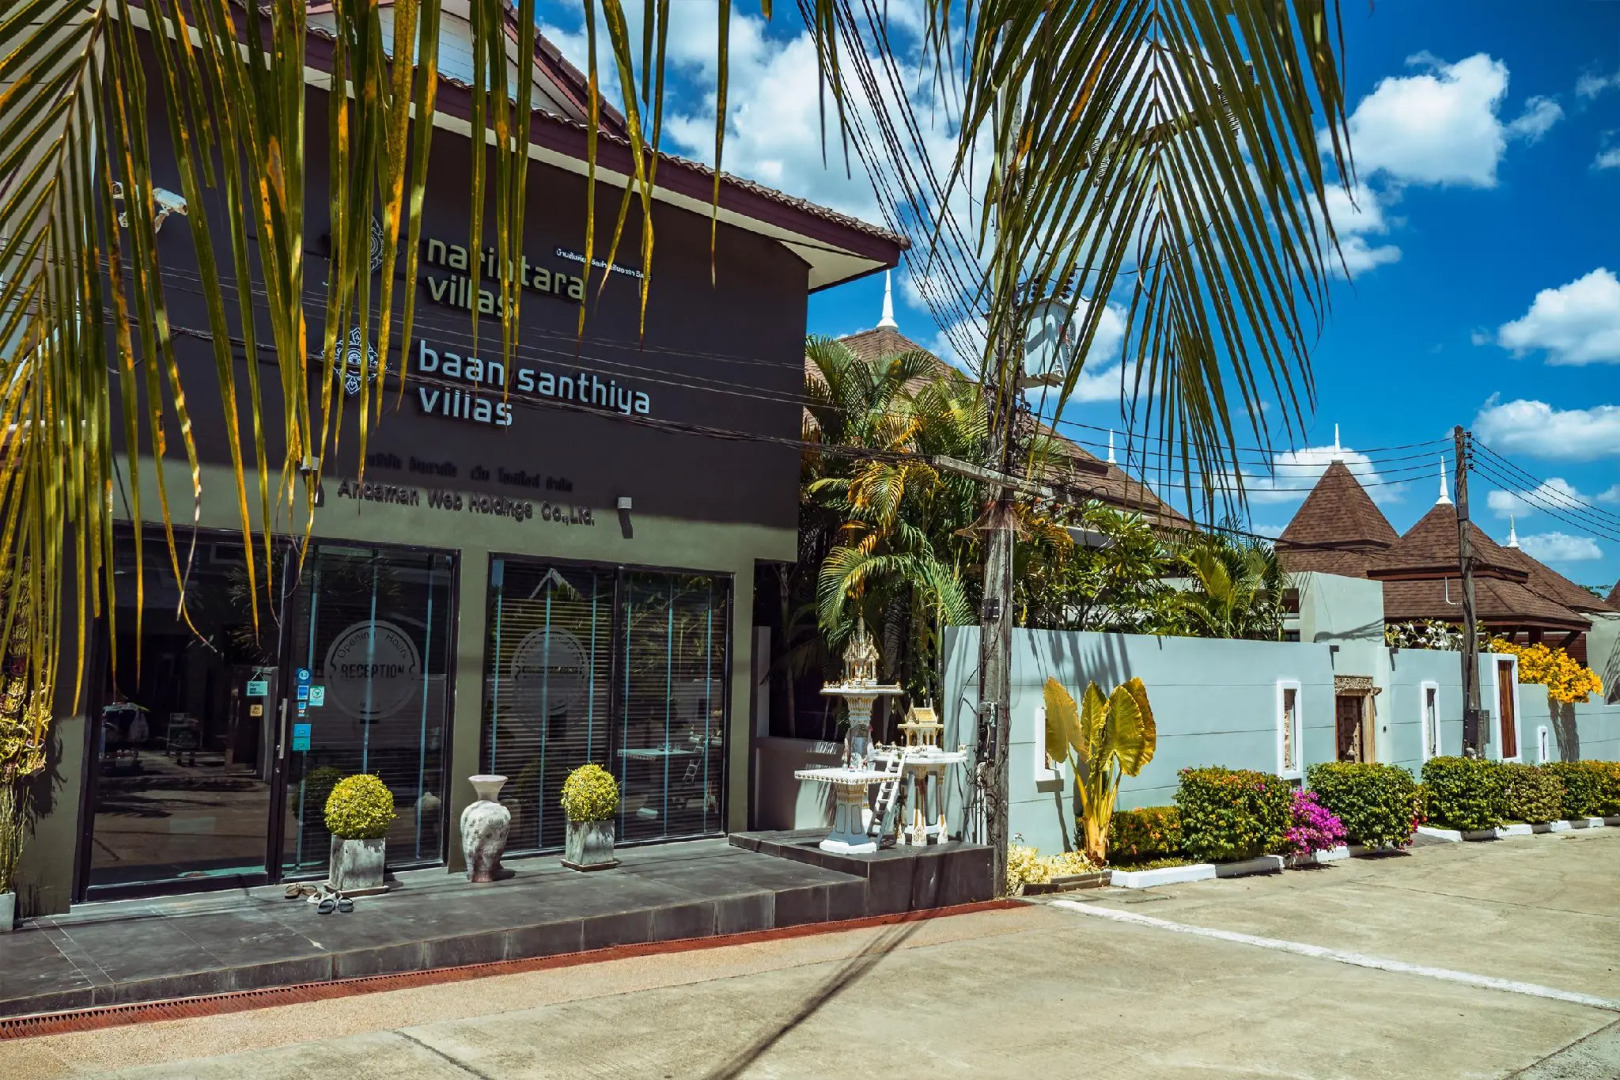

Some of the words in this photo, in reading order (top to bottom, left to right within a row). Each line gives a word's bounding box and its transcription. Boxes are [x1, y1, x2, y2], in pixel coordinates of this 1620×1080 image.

[428, 238, 584, 300] naintara
[427, 274, 514, 318] villas
[419, 339, 504, 386] baan
[517, 368, 650, 415] santhiya
[418, 387, 513, 426] villas
[337, 479, 420, 506] Andaman
[427, 488, 463, 512] Web
[468, 492, 533, 522] Holdings
[337, 631, 377, 658] Openin
[341, 663, 405, 679] RECEPTION
